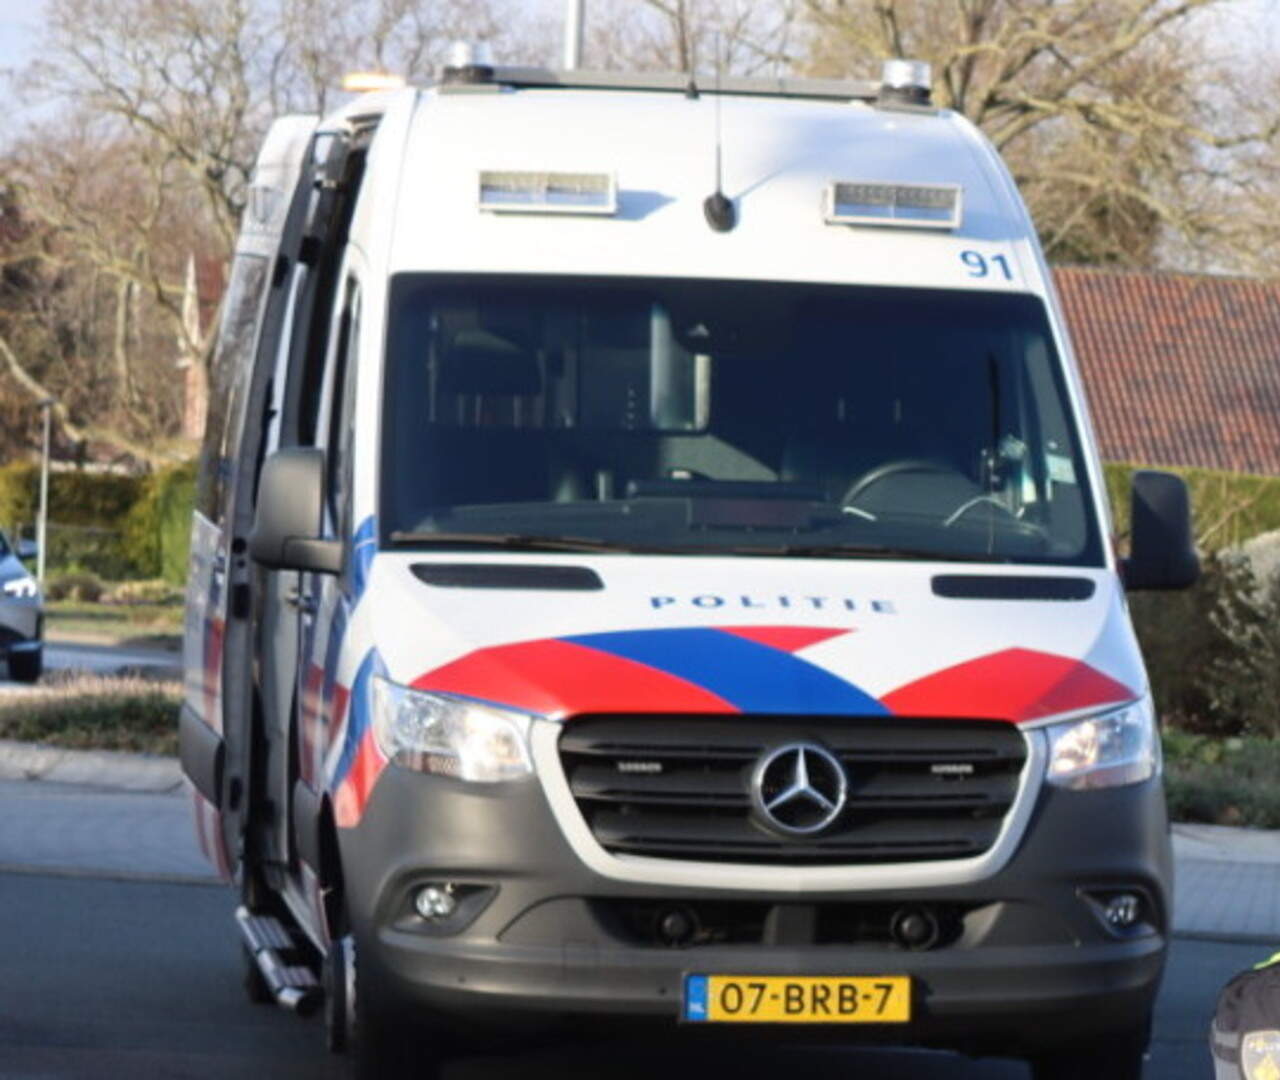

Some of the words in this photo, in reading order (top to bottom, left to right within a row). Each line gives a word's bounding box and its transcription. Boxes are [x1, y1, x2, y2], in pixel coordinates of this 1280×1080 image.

[961, 250, 1012, 281] 91
[650, 595, 897, 613] POLITIE
[720, 983, 894, 1015] 07-BRB-7
